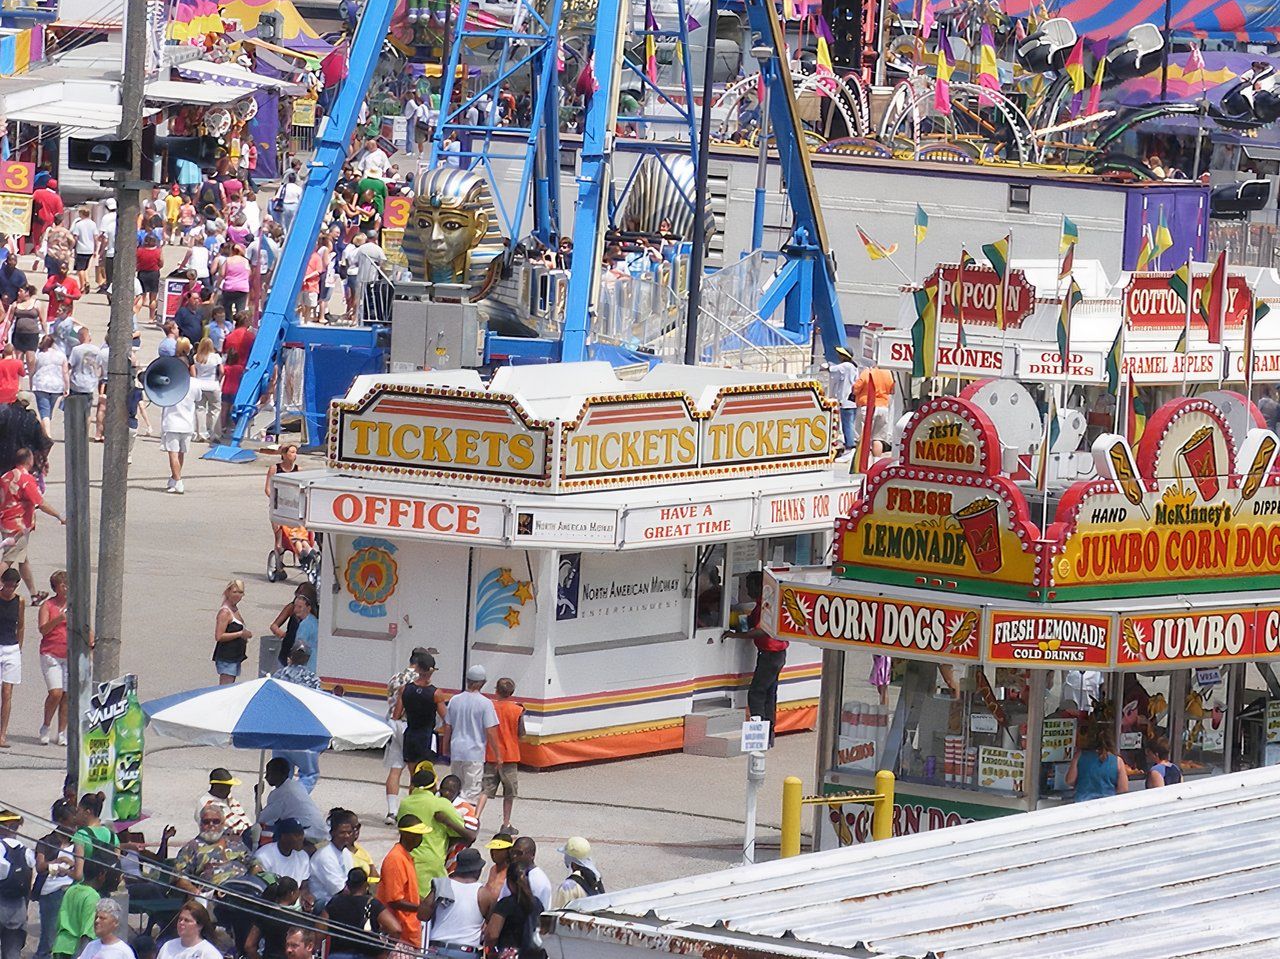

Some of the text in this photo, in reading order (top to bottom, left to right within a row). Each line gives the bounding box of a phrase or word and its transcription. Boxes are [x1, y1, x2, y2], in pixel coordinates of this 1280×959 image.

[5, 164, 29, 190] 3
[389, 199, 410, 226] 3
[940, 280, 1022, 312] POPCON
[891, 343, 1003, 370] SN KONES
[1040, 352, 1083, 364] COD
[1121, 355, 1168, 374] ARAMEL
[350, 419, 534, 470] TICKETS
[571, 415, 827, 472] TICKETS TICKETS
[928, 423, 962, 440] ZESTY
[915, 440, 975, 464] NACHOS
[332, 493, 480, 535] OFFICE
[660, 504, 713, 520] HAVE A
[771, 494, 805, 523] THANKS
[813, 494, 829, 518] FOR
[886, 487, 953, 516] FRESH
[1155, 502, 1231, 528] McKinney's
[1091, 508, 1127, 523] HAND
[644, 520, 731, 539] GREAT TIME
[863, 523, 967, 566] LEMONADE
[1077, 530, 1160, 578] JUMBO
[1165, 527, 1230, 571] CORN
[582, 583, 608, 601] NORTH
[609, 581, 649, 599] AMERICAN
[813, 594, 946, 651] CORN DOGS
[993, 618, 1106, 649] FRESH LEMONADE
[1145, 613, 1245, 660] JUMBO
[1013, 648, 1084, 661] COLD DRINKS
[84, 700, 128, 729] VAULT
